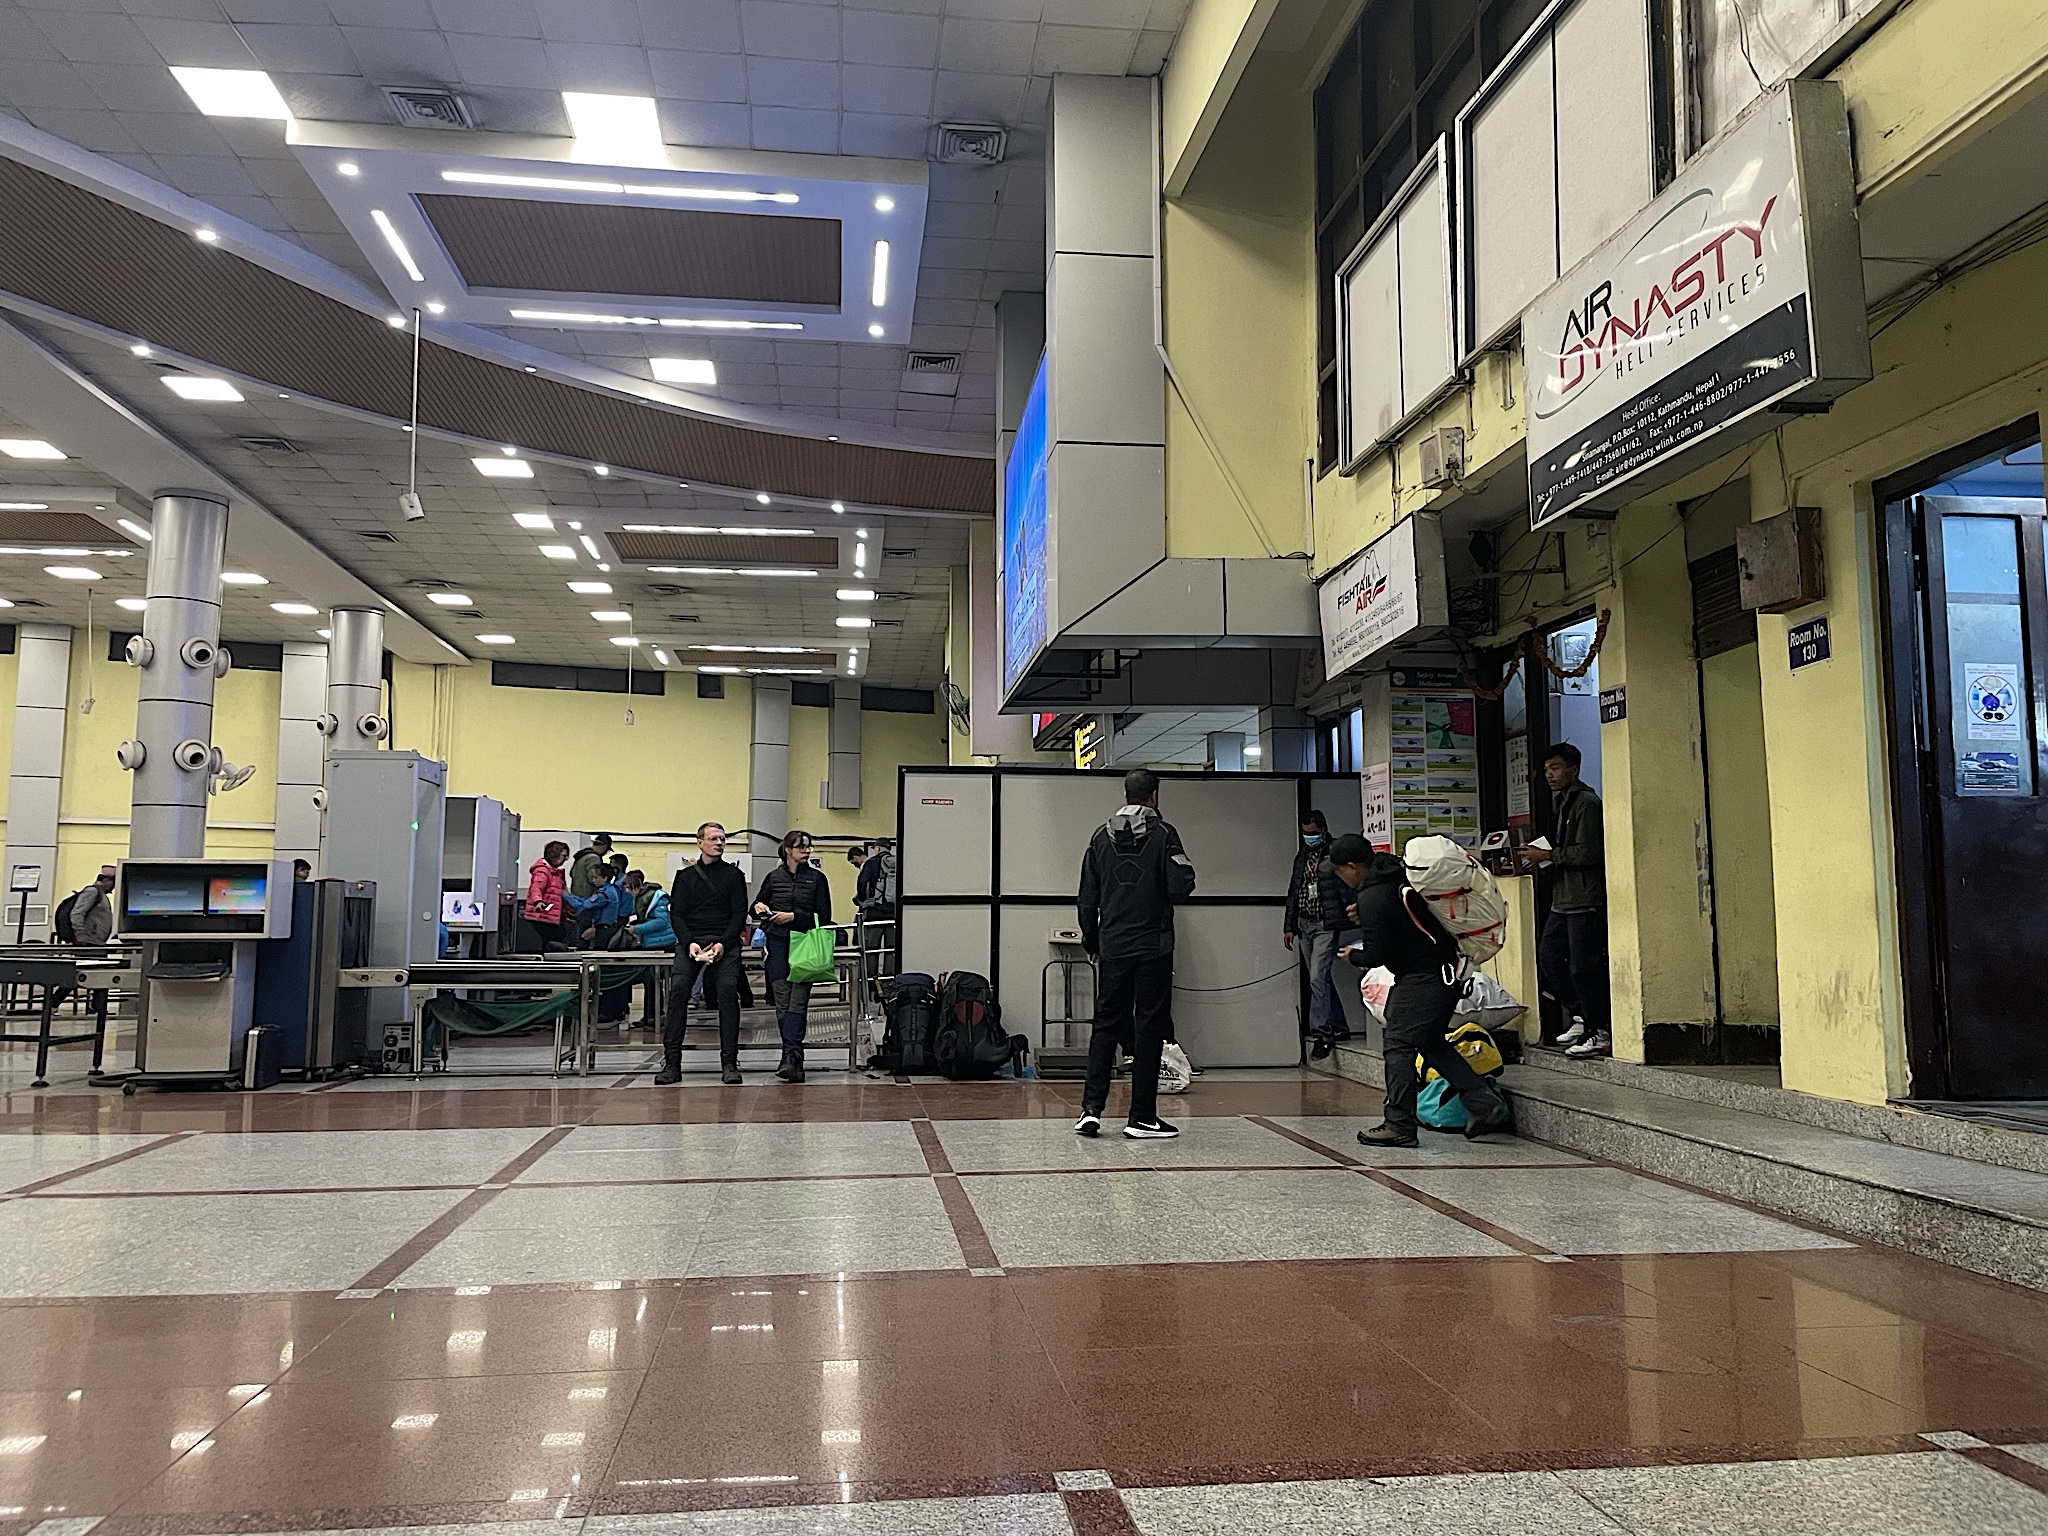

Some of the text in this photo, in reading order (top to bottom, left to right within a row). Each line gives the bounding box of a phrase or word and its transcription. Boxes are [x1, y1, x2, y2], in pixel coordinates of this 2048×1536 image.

[1559, 195, 1778, 394] DYNASTY
[1559, 280, 1612, 355] AIR
[1615, 263, 1766, 380] HELI SERVICES
[1622, 392, 1662, 423] Head Office:
[1637, 411, 1658, 431] 10112,
[1657, 391, 1695, 419] Kathmandu,
[1695, 374, 1716, 396] Nepal
[1649, 425, 1663, 440] Fax:
[1337, 574, 1372, 610] FISHTAIL
[1355, 588, 1373, 615] AIR
[1790, 623, 1827, 648] Room No.
[1803, 643, 1817, 662] 130
[1600, 694, 1616, 707] Room
